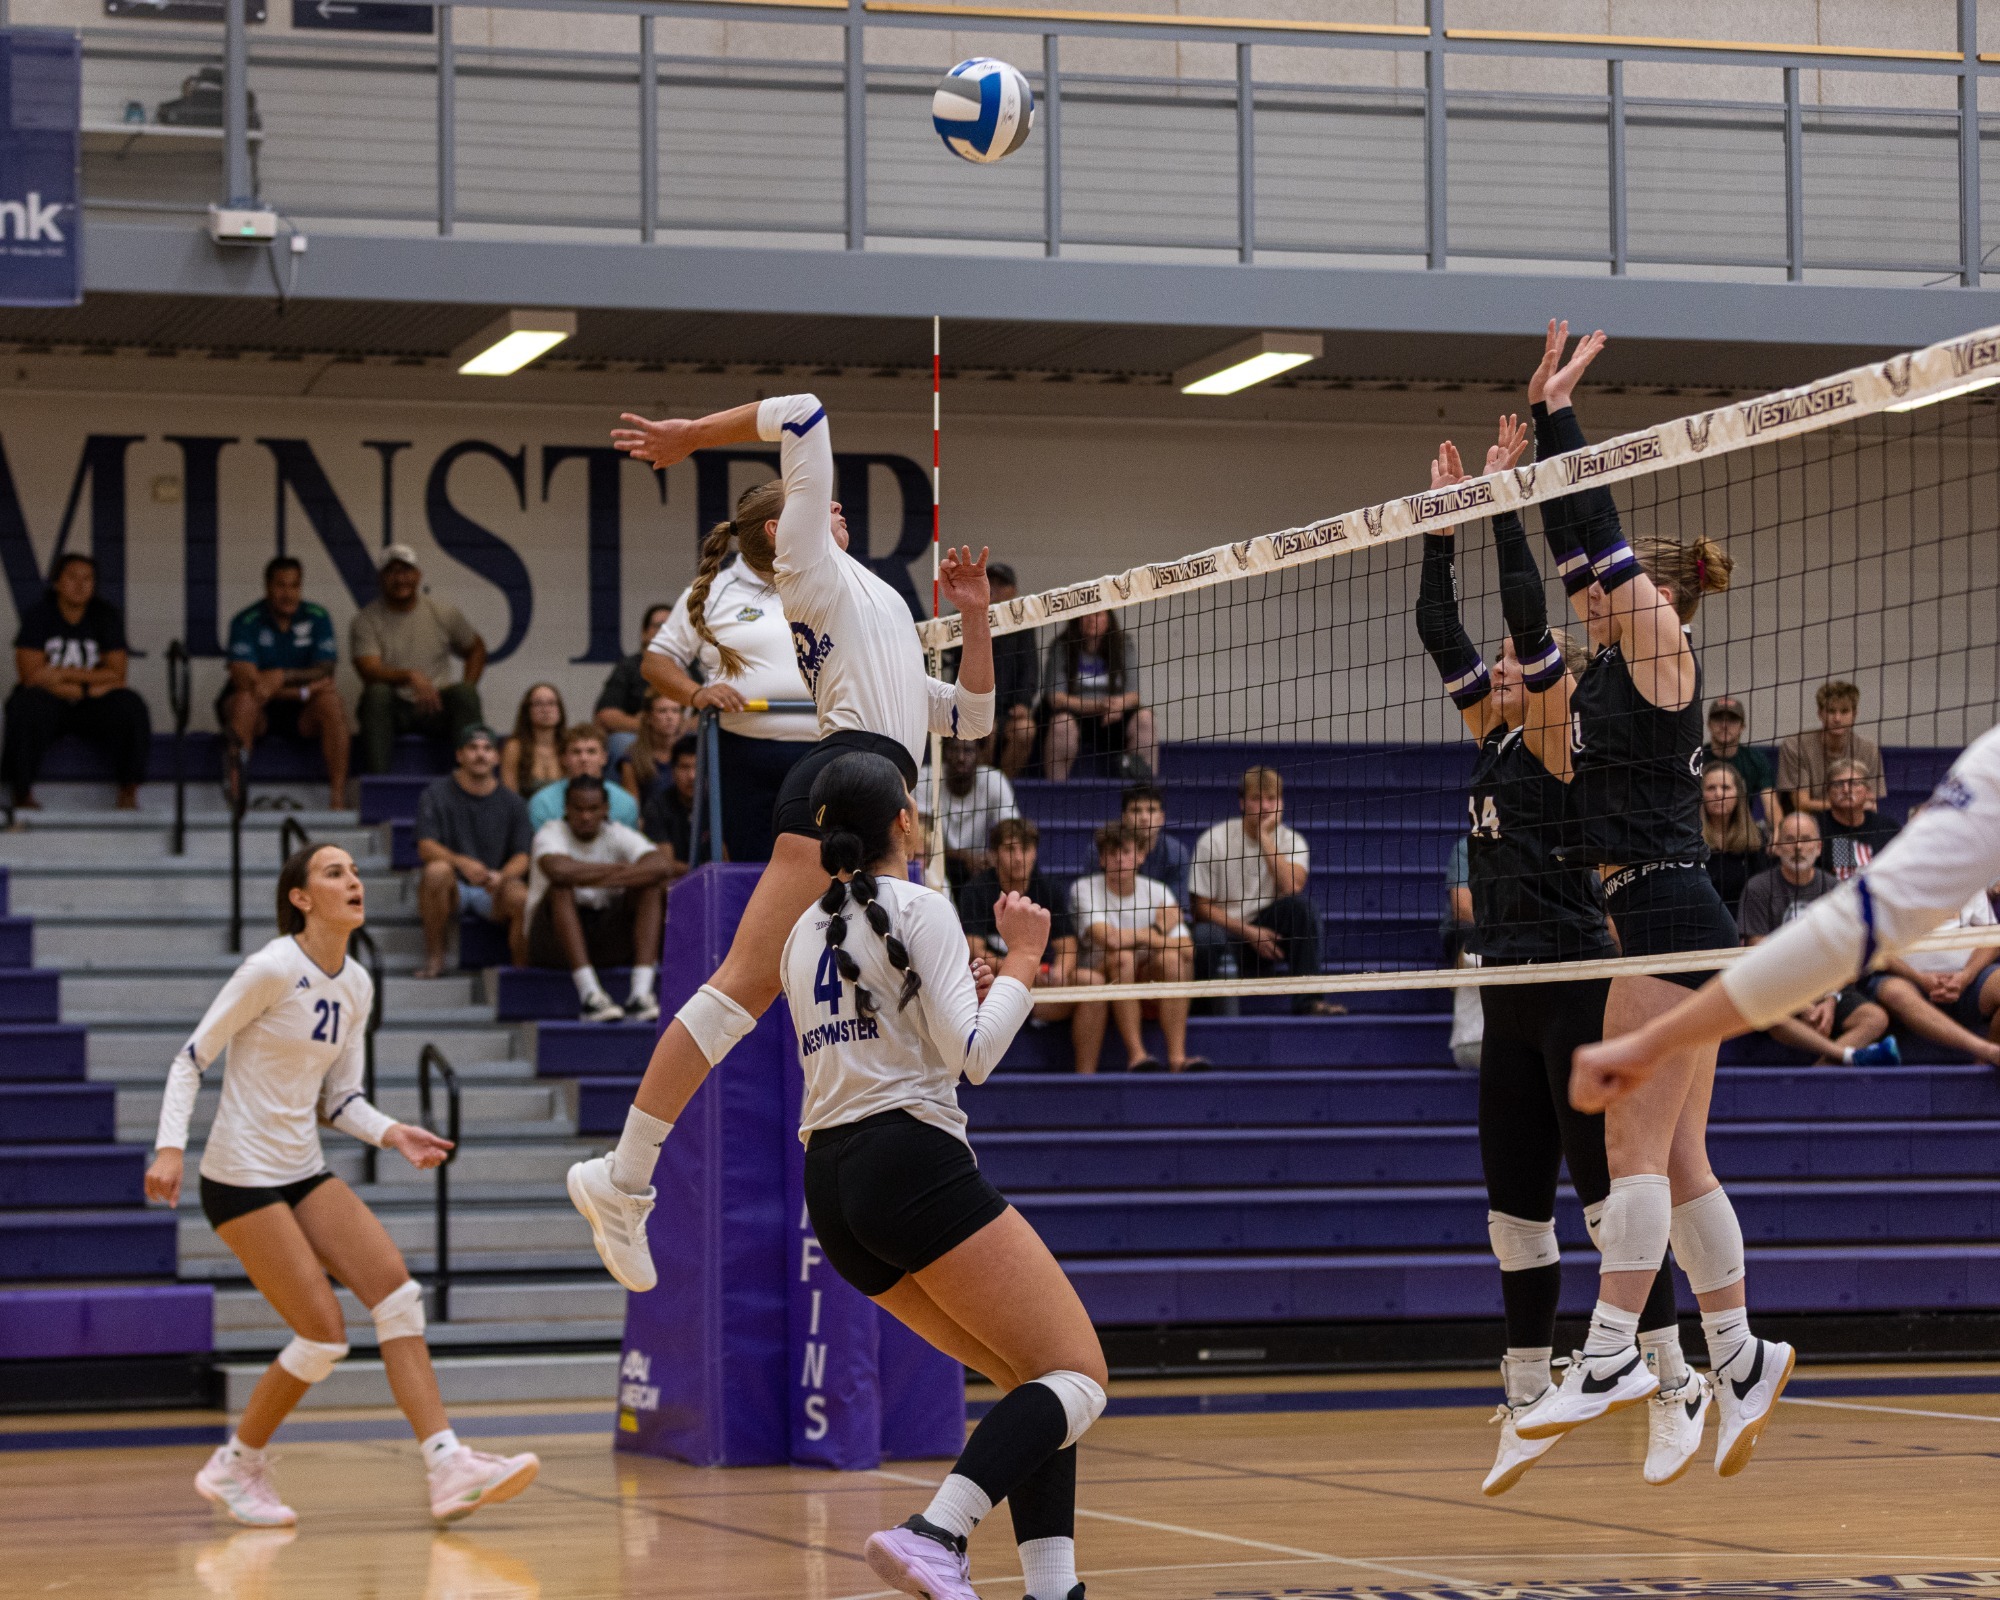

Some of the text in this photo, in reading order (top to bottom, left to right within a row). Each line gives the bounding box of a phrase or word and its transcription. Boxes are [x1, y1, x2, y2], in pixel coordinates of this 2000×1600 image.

[1403, 482, 1494, 524] WESTMINSTER
[1561, 435, 1662, 486] WESTMINSTER
[1469, 796, 1502, 839] 14
[1603, 869, 1635, 899] NIKE
[814, 943, 842, 1016] 4
[312, 998, 341, 1044] 21
